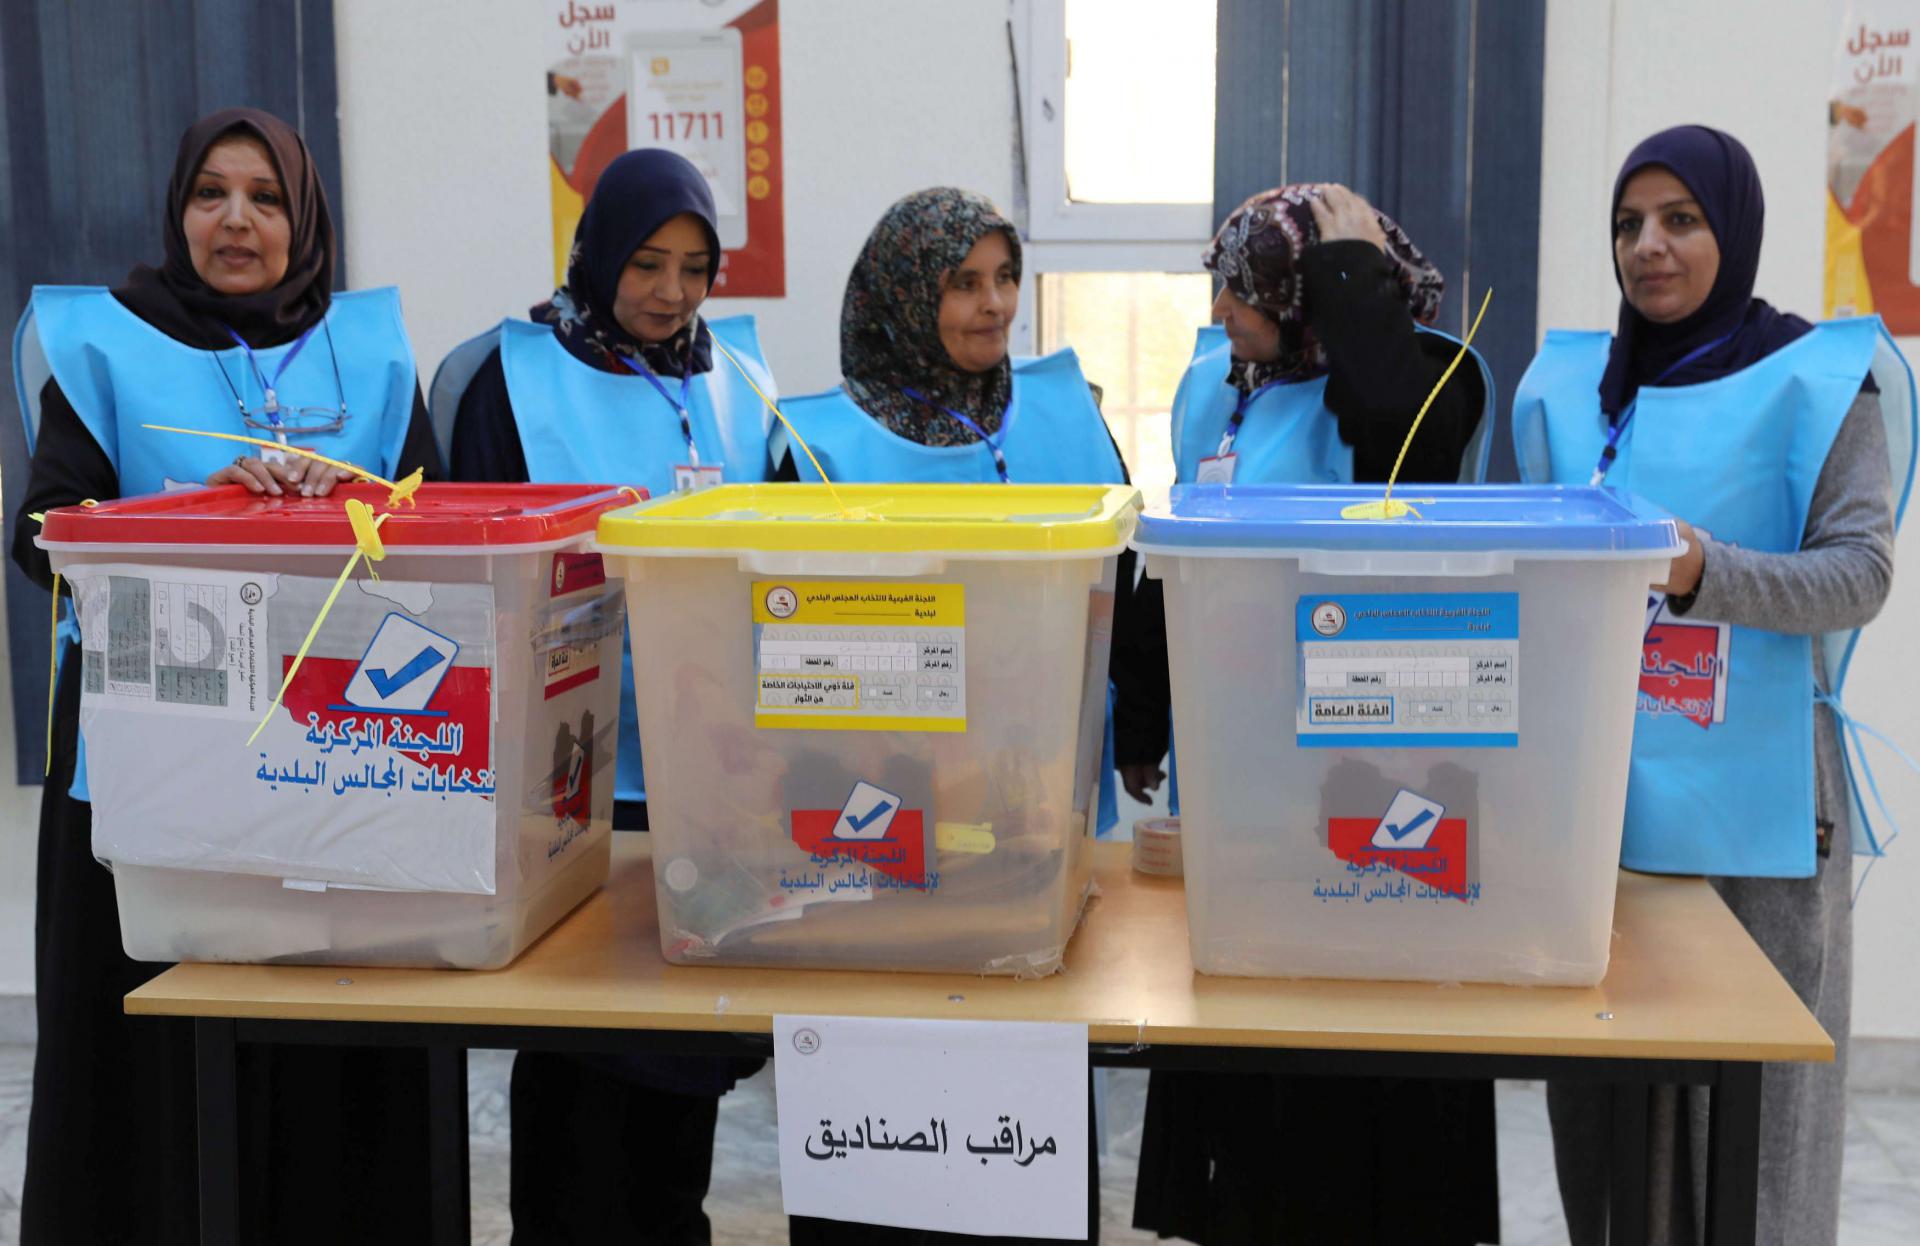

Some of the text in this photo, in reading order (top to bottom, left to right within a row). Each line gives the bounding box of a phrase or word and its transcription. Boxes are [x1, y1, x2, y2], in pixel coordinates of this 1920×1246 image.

[559, 0, 615, 28] سجل
[1848, 24, 1910, 55] سجل
[648, 112, 724, 140] 11711
[813, 695, 824, 703] من
[1315, 703, 1389, 717] الفئة العامة
[306, 715, 462, 759] اللجنة المركزية
[256, 753, 496, 800] نتخابات المجالس البلدية
[810, 845, 907, 868] اللجنة المركزية
[1346, 853, 1448, 877] اللجنة المركزية
[779, 869, 824, 893] البلدية
[829, 867, 872, 893] المجالس
[1313, 878, 1360, 903] البلدية
[1364, 876, 1411, 903] المجالس
[805, 1115, 1057, 1167] مراقب الصناديق
